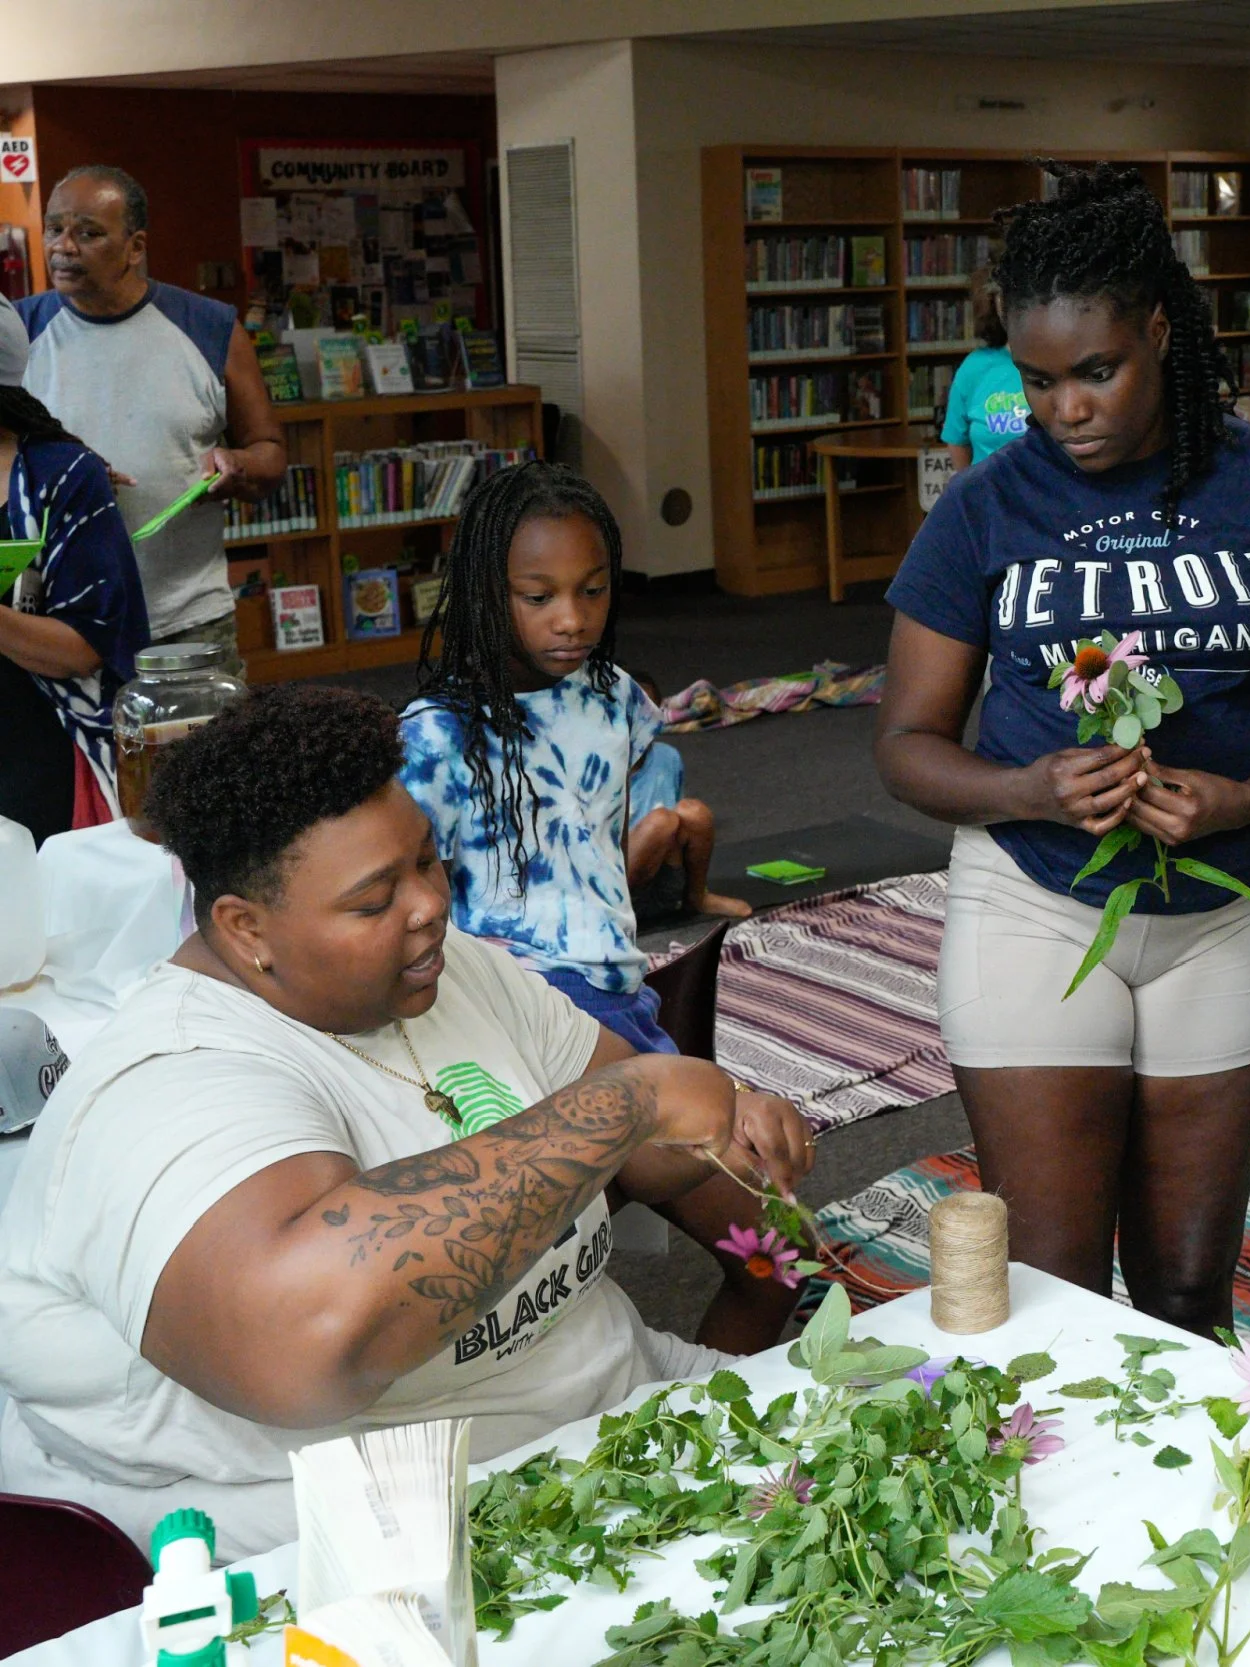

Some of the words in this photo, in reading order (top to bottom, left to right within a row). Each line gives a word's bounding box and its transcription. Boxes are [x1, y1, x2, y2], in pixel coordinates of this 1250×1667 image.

[2, 141, 29, 152] AED
[271, 160, 381, 184] COMMUNITY
[386, 159, 449, 180] BOARD
[1063, 511, 1135, 541] MOTOR
[1151, 510, 1200, 529] CTY
[1096, 529, 1171, 554] Original
[455, 1264, 573, 1366] BLACK
[496, 1332, 535, 1361] WITH
